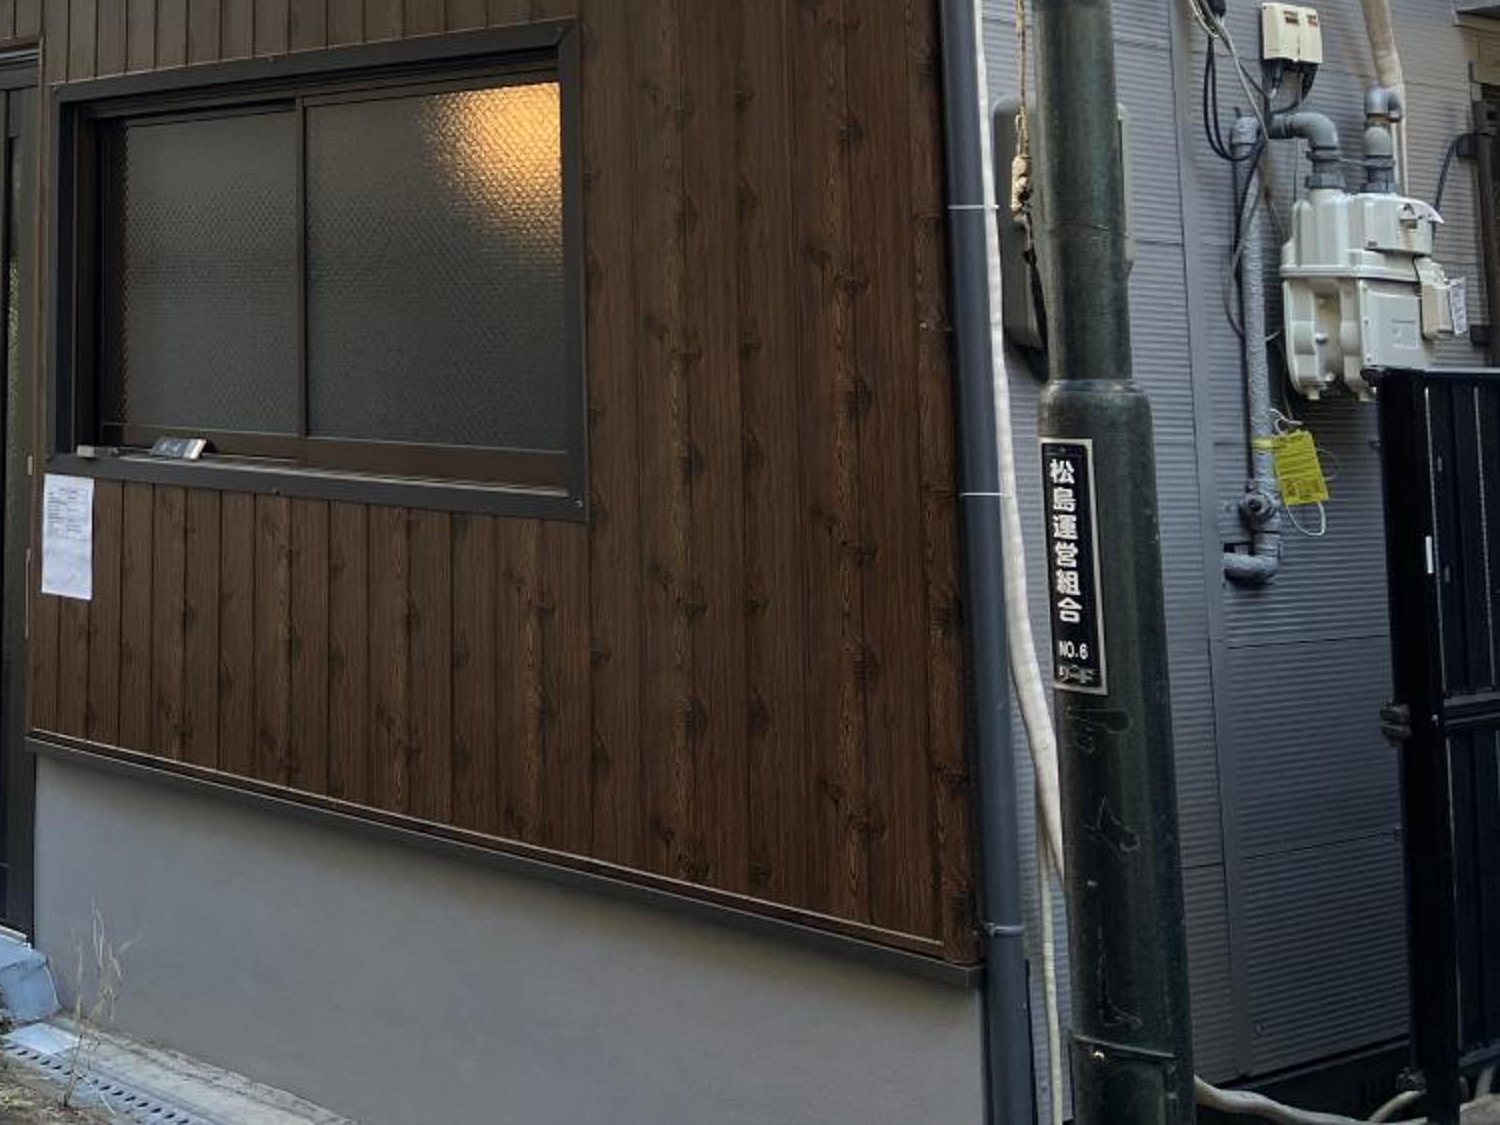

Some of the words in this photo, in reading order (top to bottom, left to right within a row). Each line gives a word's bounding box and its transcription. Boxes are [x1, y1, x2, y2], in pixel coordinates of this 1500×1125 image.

[1050, 459, 1082, 623] 松島運営組合
[1059, 641, 1088, 659] NO.6
